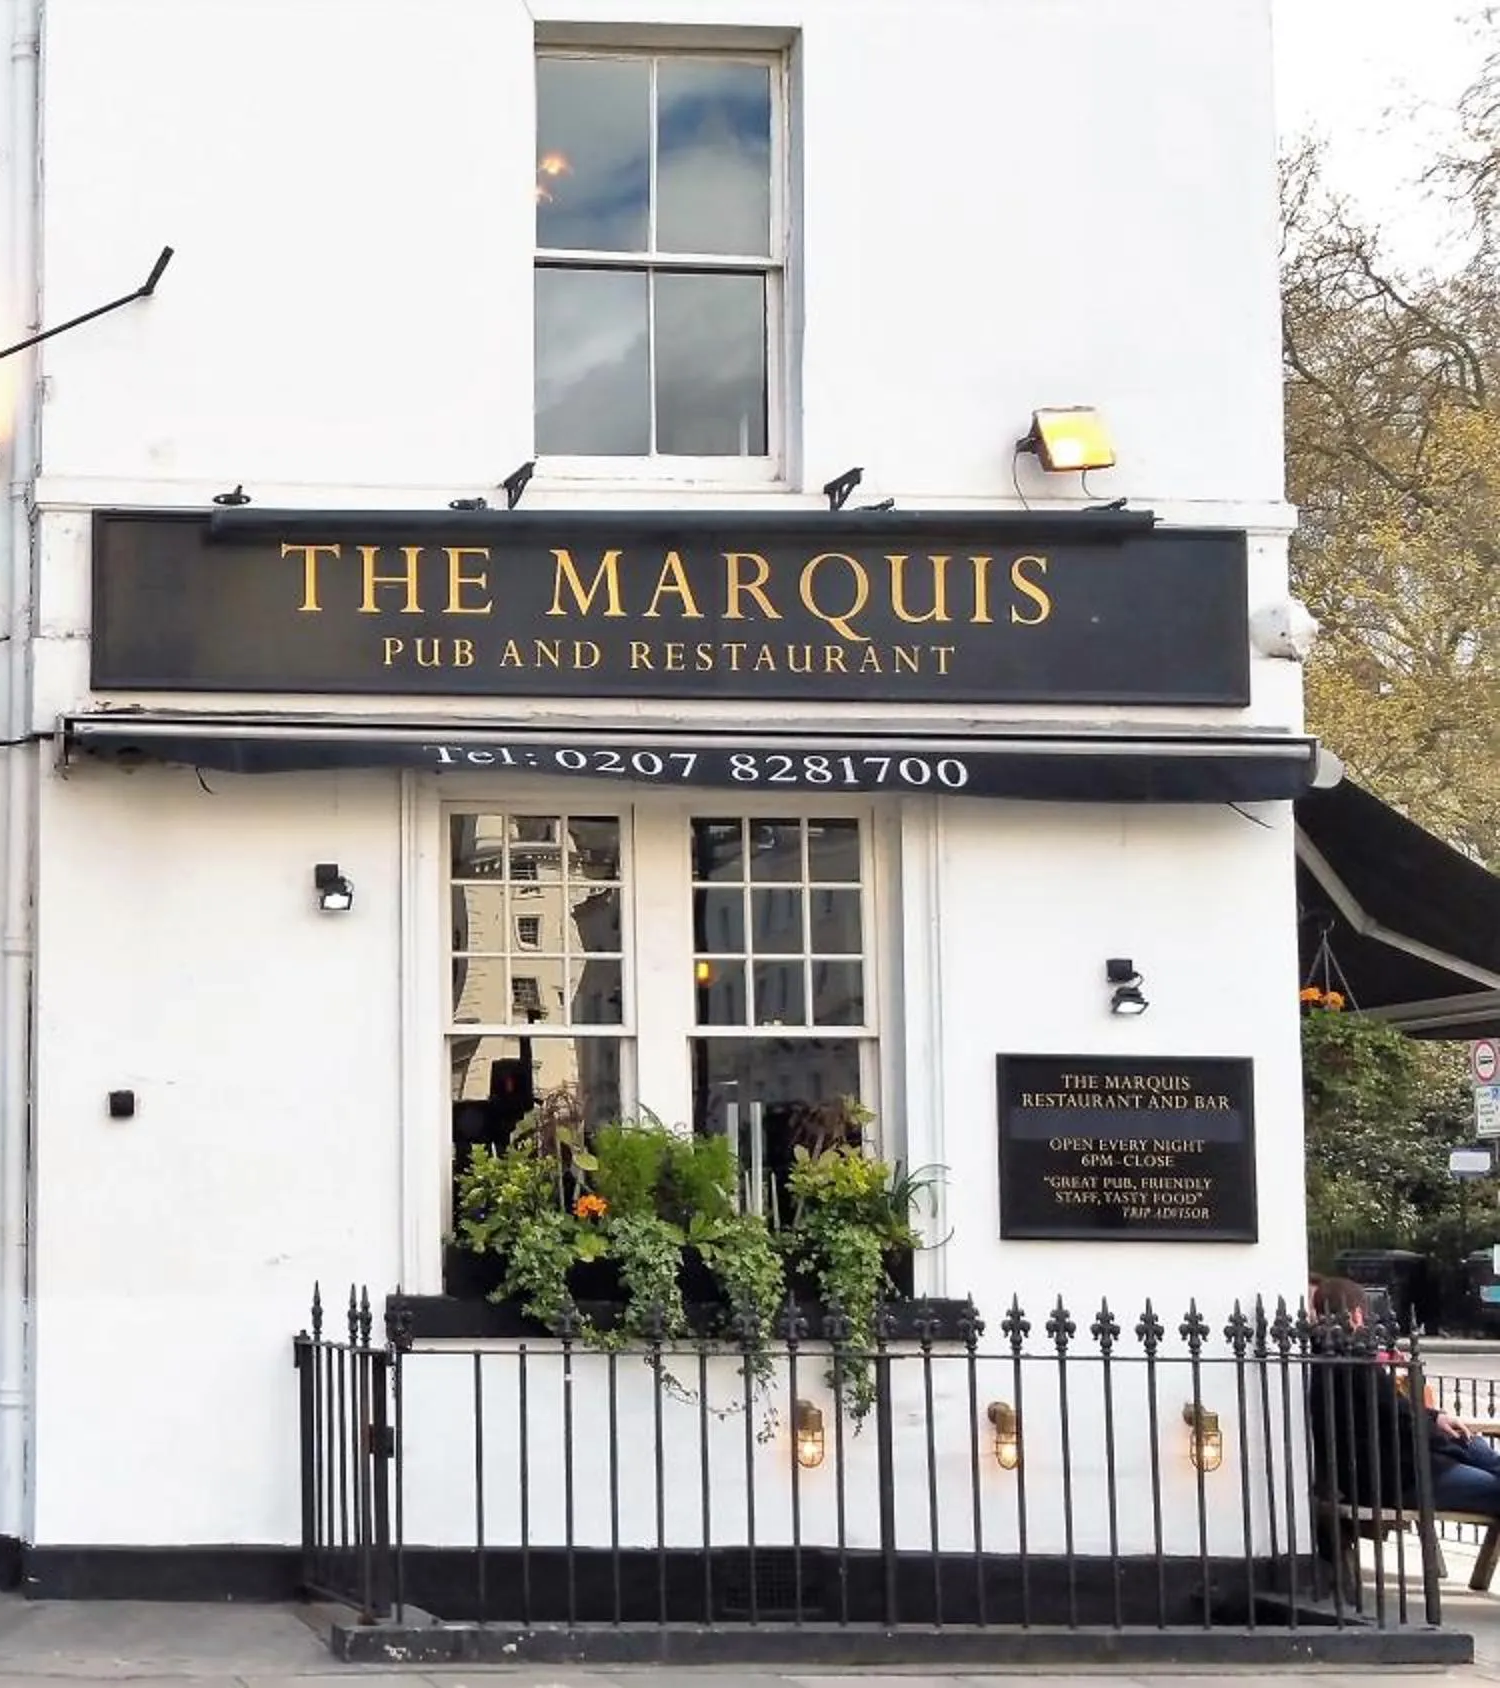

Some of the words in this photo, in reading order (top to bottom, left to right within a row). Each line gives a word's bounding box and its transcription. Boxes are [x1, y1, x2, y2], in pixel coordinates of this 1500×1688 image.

[281, 543, 494, 614] THE
[546, 548, 1052, 641] MARQUIS
[382, 637, 476, 668] PUB
[500, 639, 601, 670] AND
[629, 641, 956, 675] RESTAURANT
[423, 745, 537, 766] Tel:
[554, 748, 698, 779] 0207
[729, 754, 969, 787] 8281700
[1060, 1073, 1099, 1090] THE
[1104, 1075, 1191, 1093] MARQUIS
[1022, 1093, 1142, 1110] RESTAURANT
[1148, 1095, 1188, 1110] AND
[1195, 1096, 1231, 1111] BAR
[1050, 1137, 1093, 1151] OPEN
[1100, 1138, 1148, 1152] EVERY
[1153, 1139, 1205, 1153] NIGHT
[1141, 1177, 1212, 1191] FRIENDLY
[1104, 1192, 1149, 1205] TASTY
